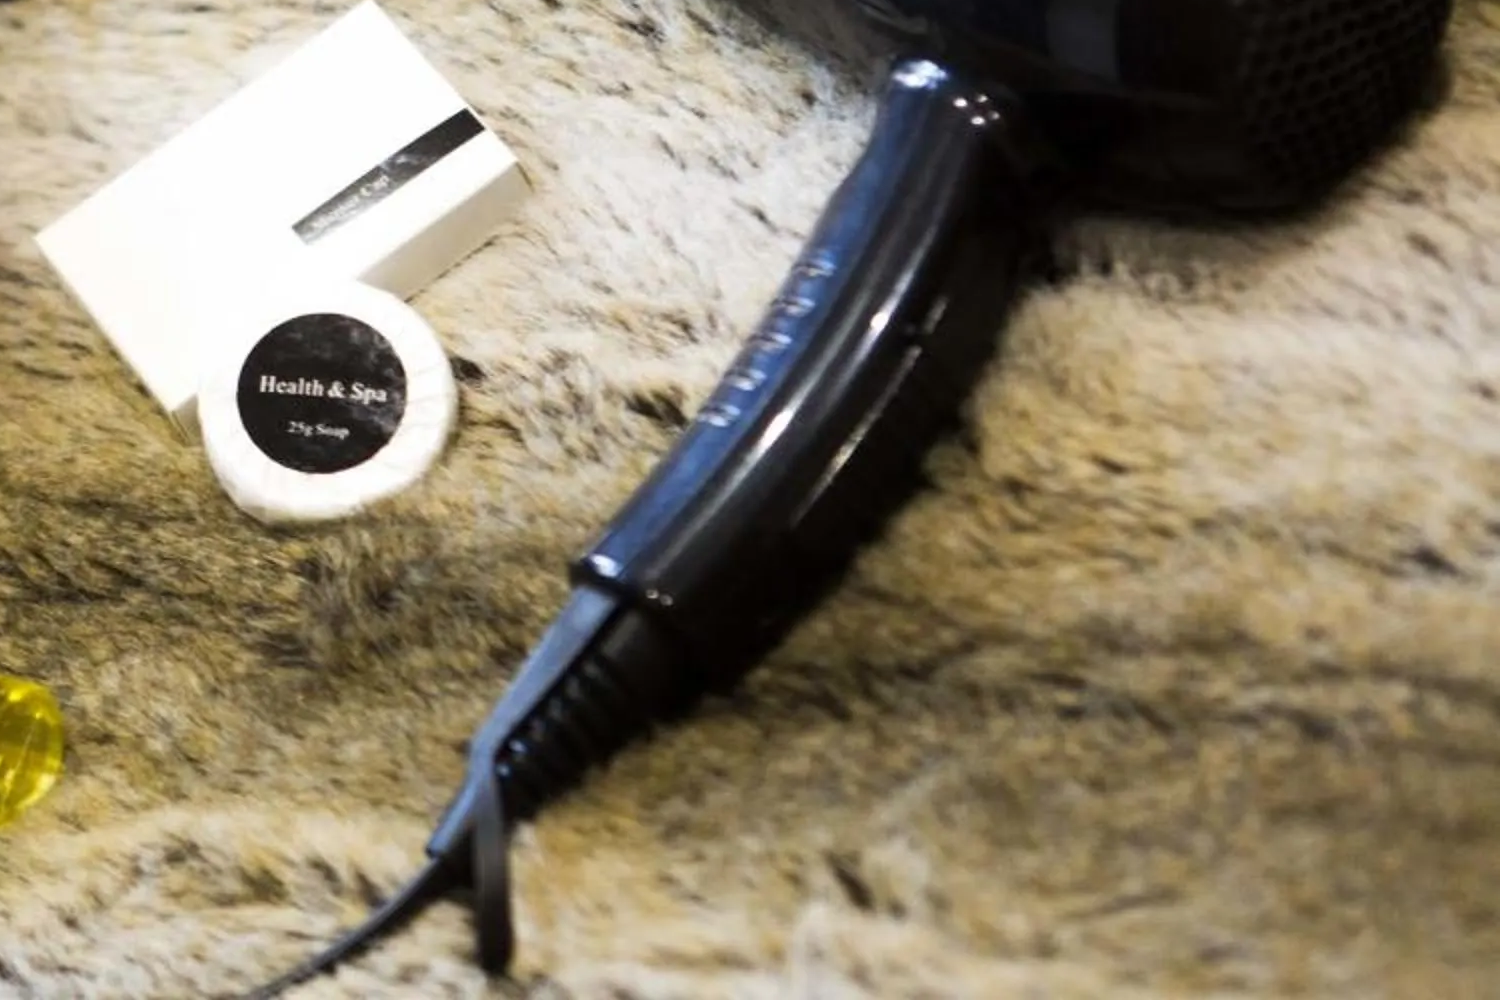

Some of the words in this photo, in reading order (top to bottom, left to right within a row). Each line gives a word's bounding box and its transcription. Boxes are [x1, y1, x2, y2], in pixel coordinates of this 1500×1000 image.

[259, 375, 325, 397] Health
[327, 380, 346, 399] &
[349, 381, 388, 405] Spa
